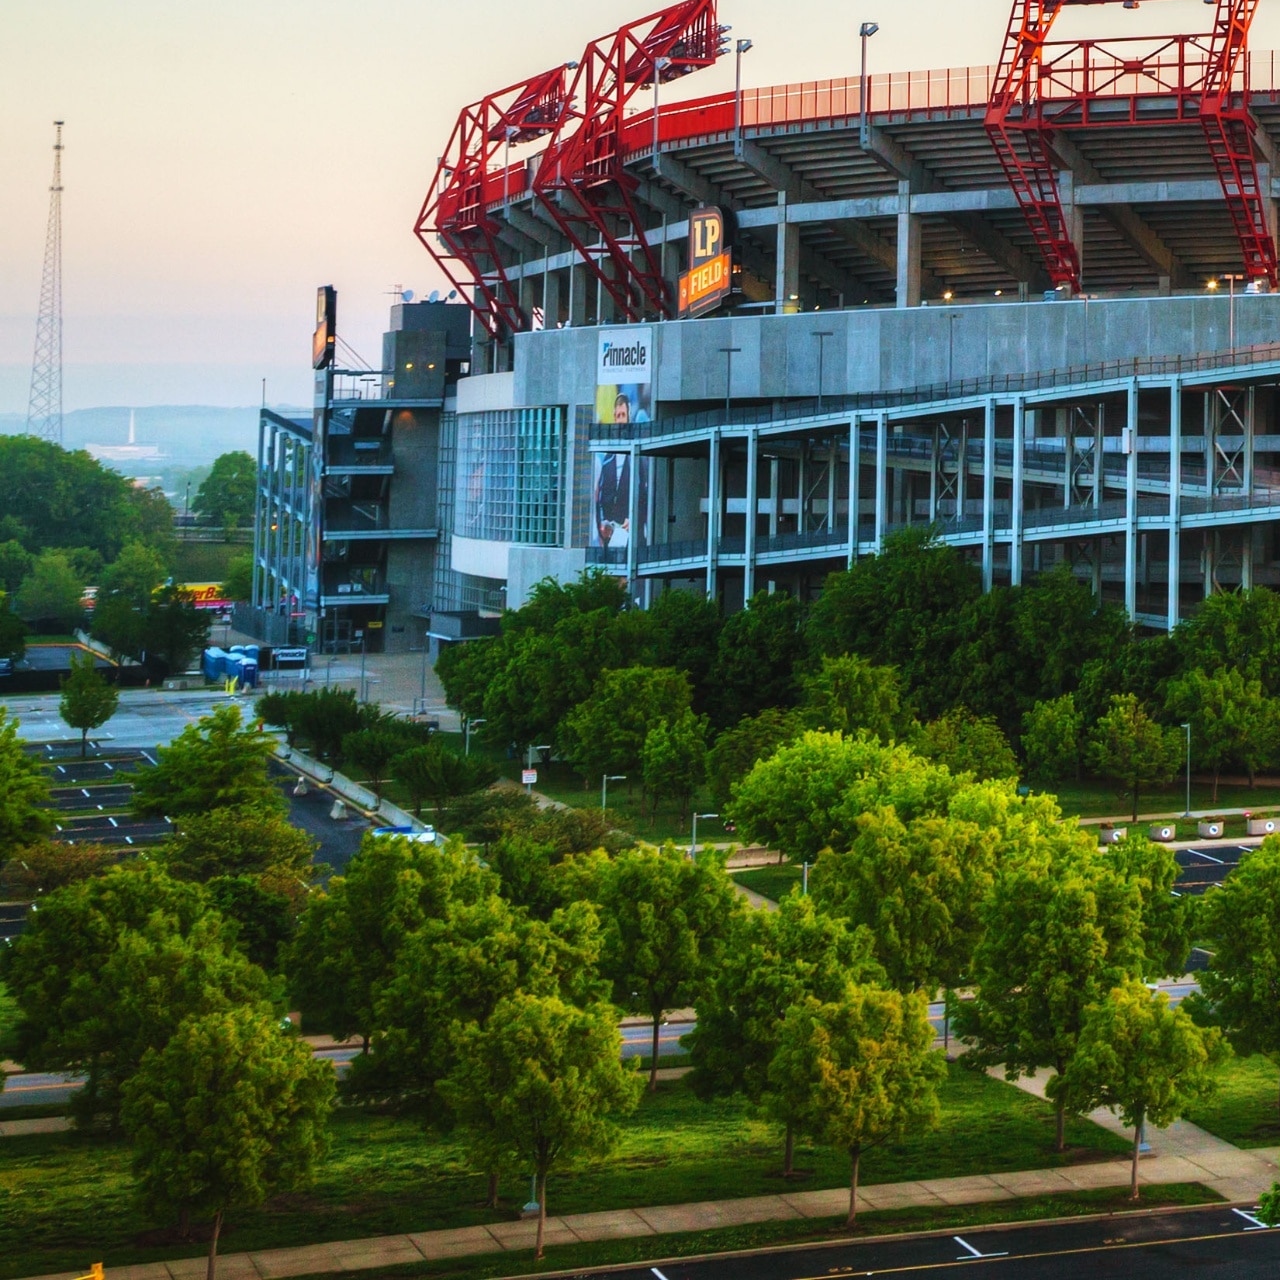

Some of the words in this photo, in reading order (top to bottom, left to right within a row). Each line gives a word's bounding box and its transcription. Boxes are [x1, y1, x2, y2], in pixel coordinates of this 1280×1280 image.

[694, 218, 720, 258] LP
[691, 261, 722, 295] FIELD
[603, 340, 647, 367] Pinnacle
